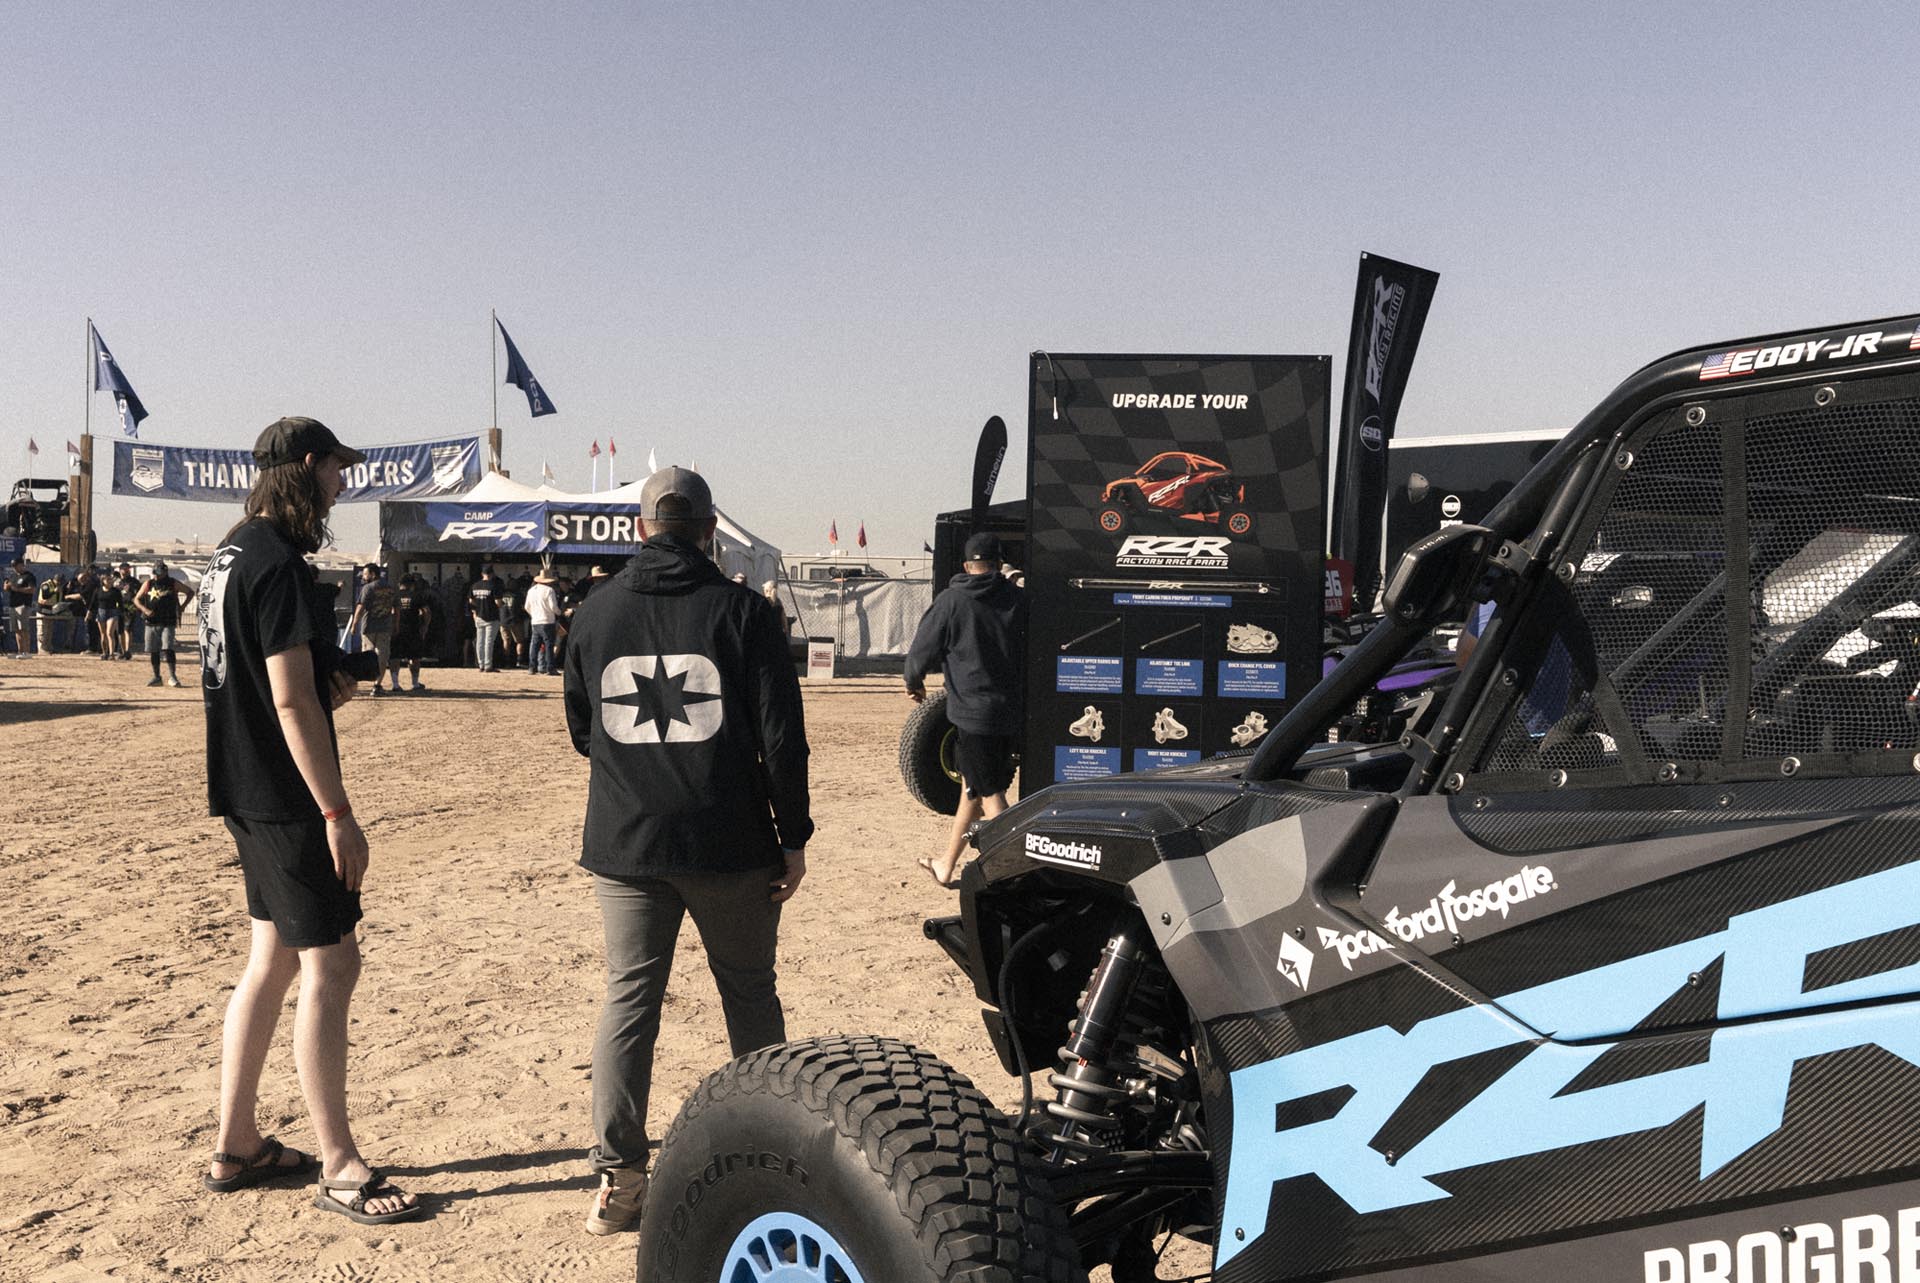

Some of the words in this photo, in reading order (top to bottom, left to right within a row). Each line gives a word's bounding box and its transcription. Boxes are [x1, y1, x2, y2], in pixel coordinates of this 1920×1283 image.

[1729, 331, 1883, 373] EDDY-JR
[1112, 393, 1195, 409] UPGRADE
[1201, 394, 1248, 409] YOUR
[340, 459, 415, 489] IDERS
[464, 511, 493, 521] CAMP
[438, 521, 539, 542] RZR
[1116, 535, 1231, 558] RZR
[1116, 557, 1164, 565] FACTORY
[1165, 558, 1193, 566] RACE
[1194, 559, 1228, 567] PARTS
[1025, 832, 1102, 864] BFGoodrich
